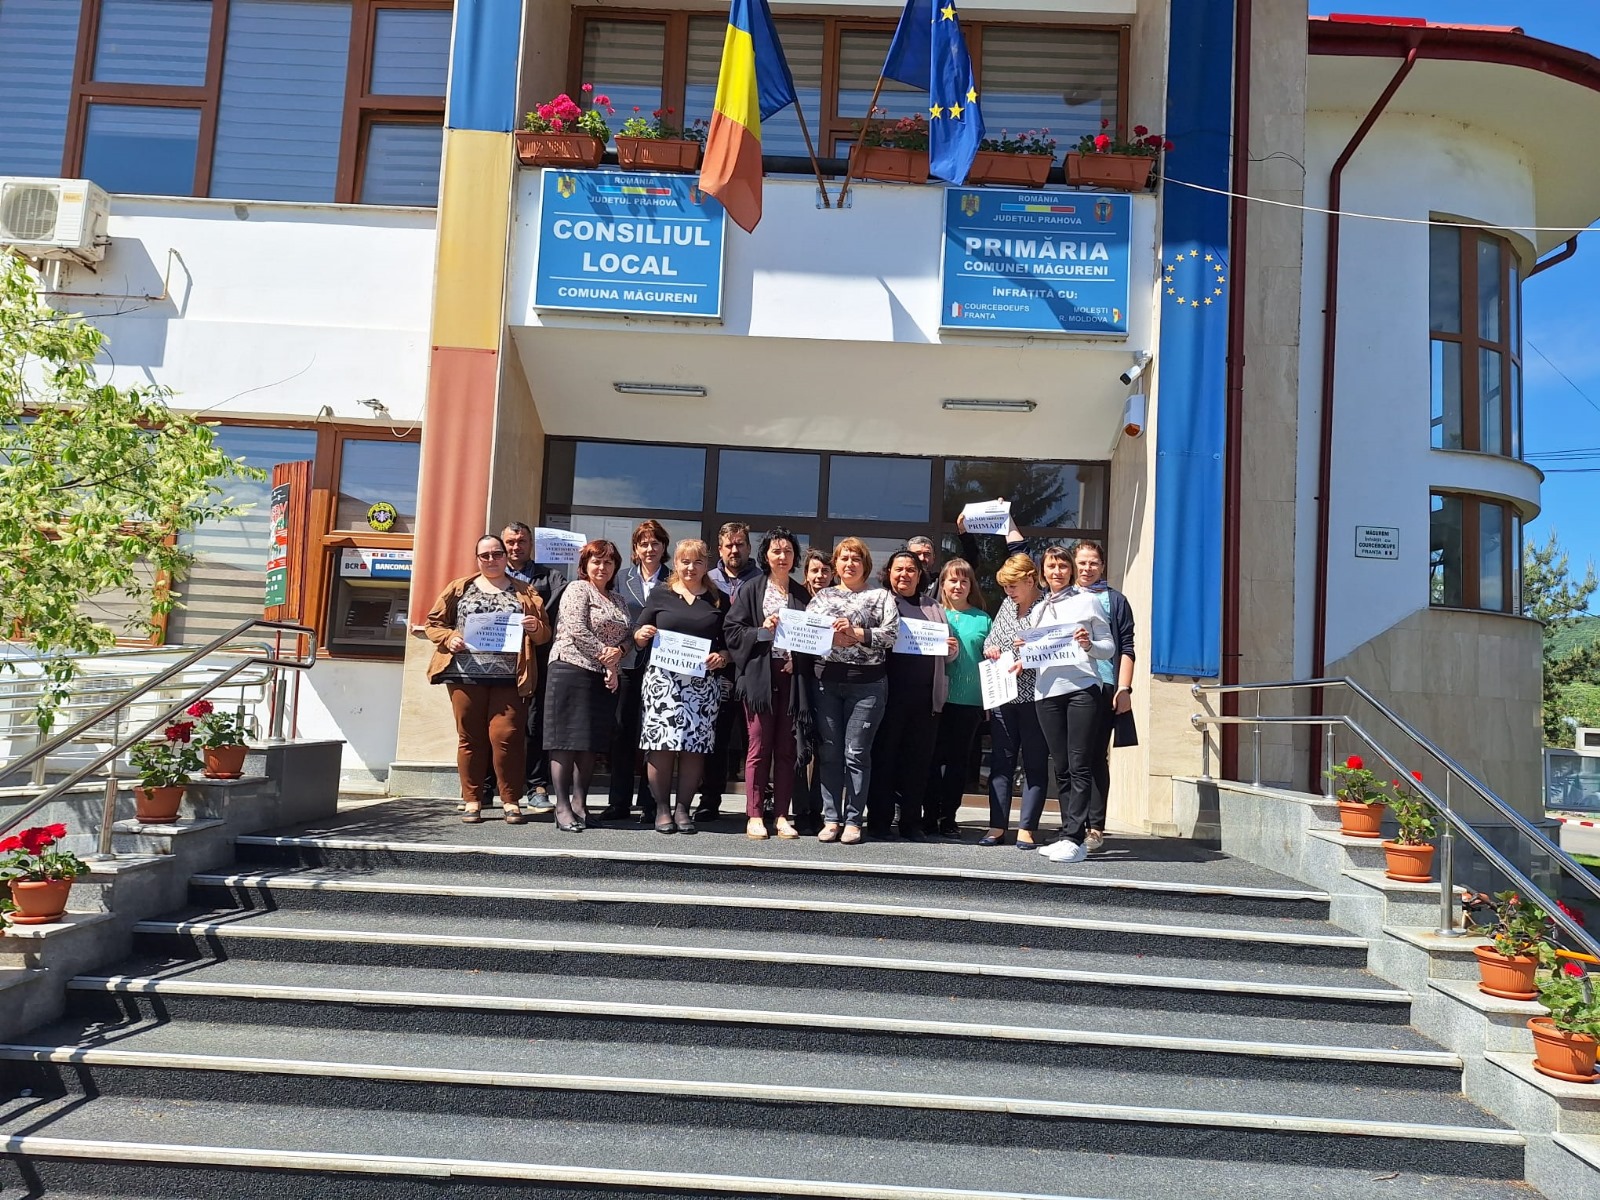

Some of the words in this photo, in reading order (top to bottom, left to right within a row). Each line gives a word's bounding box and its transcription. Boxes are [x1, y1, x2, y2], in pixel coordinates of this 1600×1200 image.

[634, 197, 678, 207] PRAHOVA
[1038, 216, 1082, 225] PRAHOVA
[553, 219, 710, 246] CONSILIUL
[965, 236, 1109, 261] PRIMĂRIA
[582, 252, 678, 276] LOCAL
[964, 261, 1028, 274] COMUNEI
[1033, 262, 1108, 276] MĂGURENI
[558, 286, 619, 300] COMUNA
[624, 289, 698, 304] MĂGURENI
[1058, 290, 1078, 300] CU:
[964, 302, 1030, 312] COURCEBOEUFS
[1068, 315, 1108, 323] MOLDOVA
[655, 655, 702, 670] PRIMĂRIA
[1026, 651, 1076, 662] PRIMĂRIA
